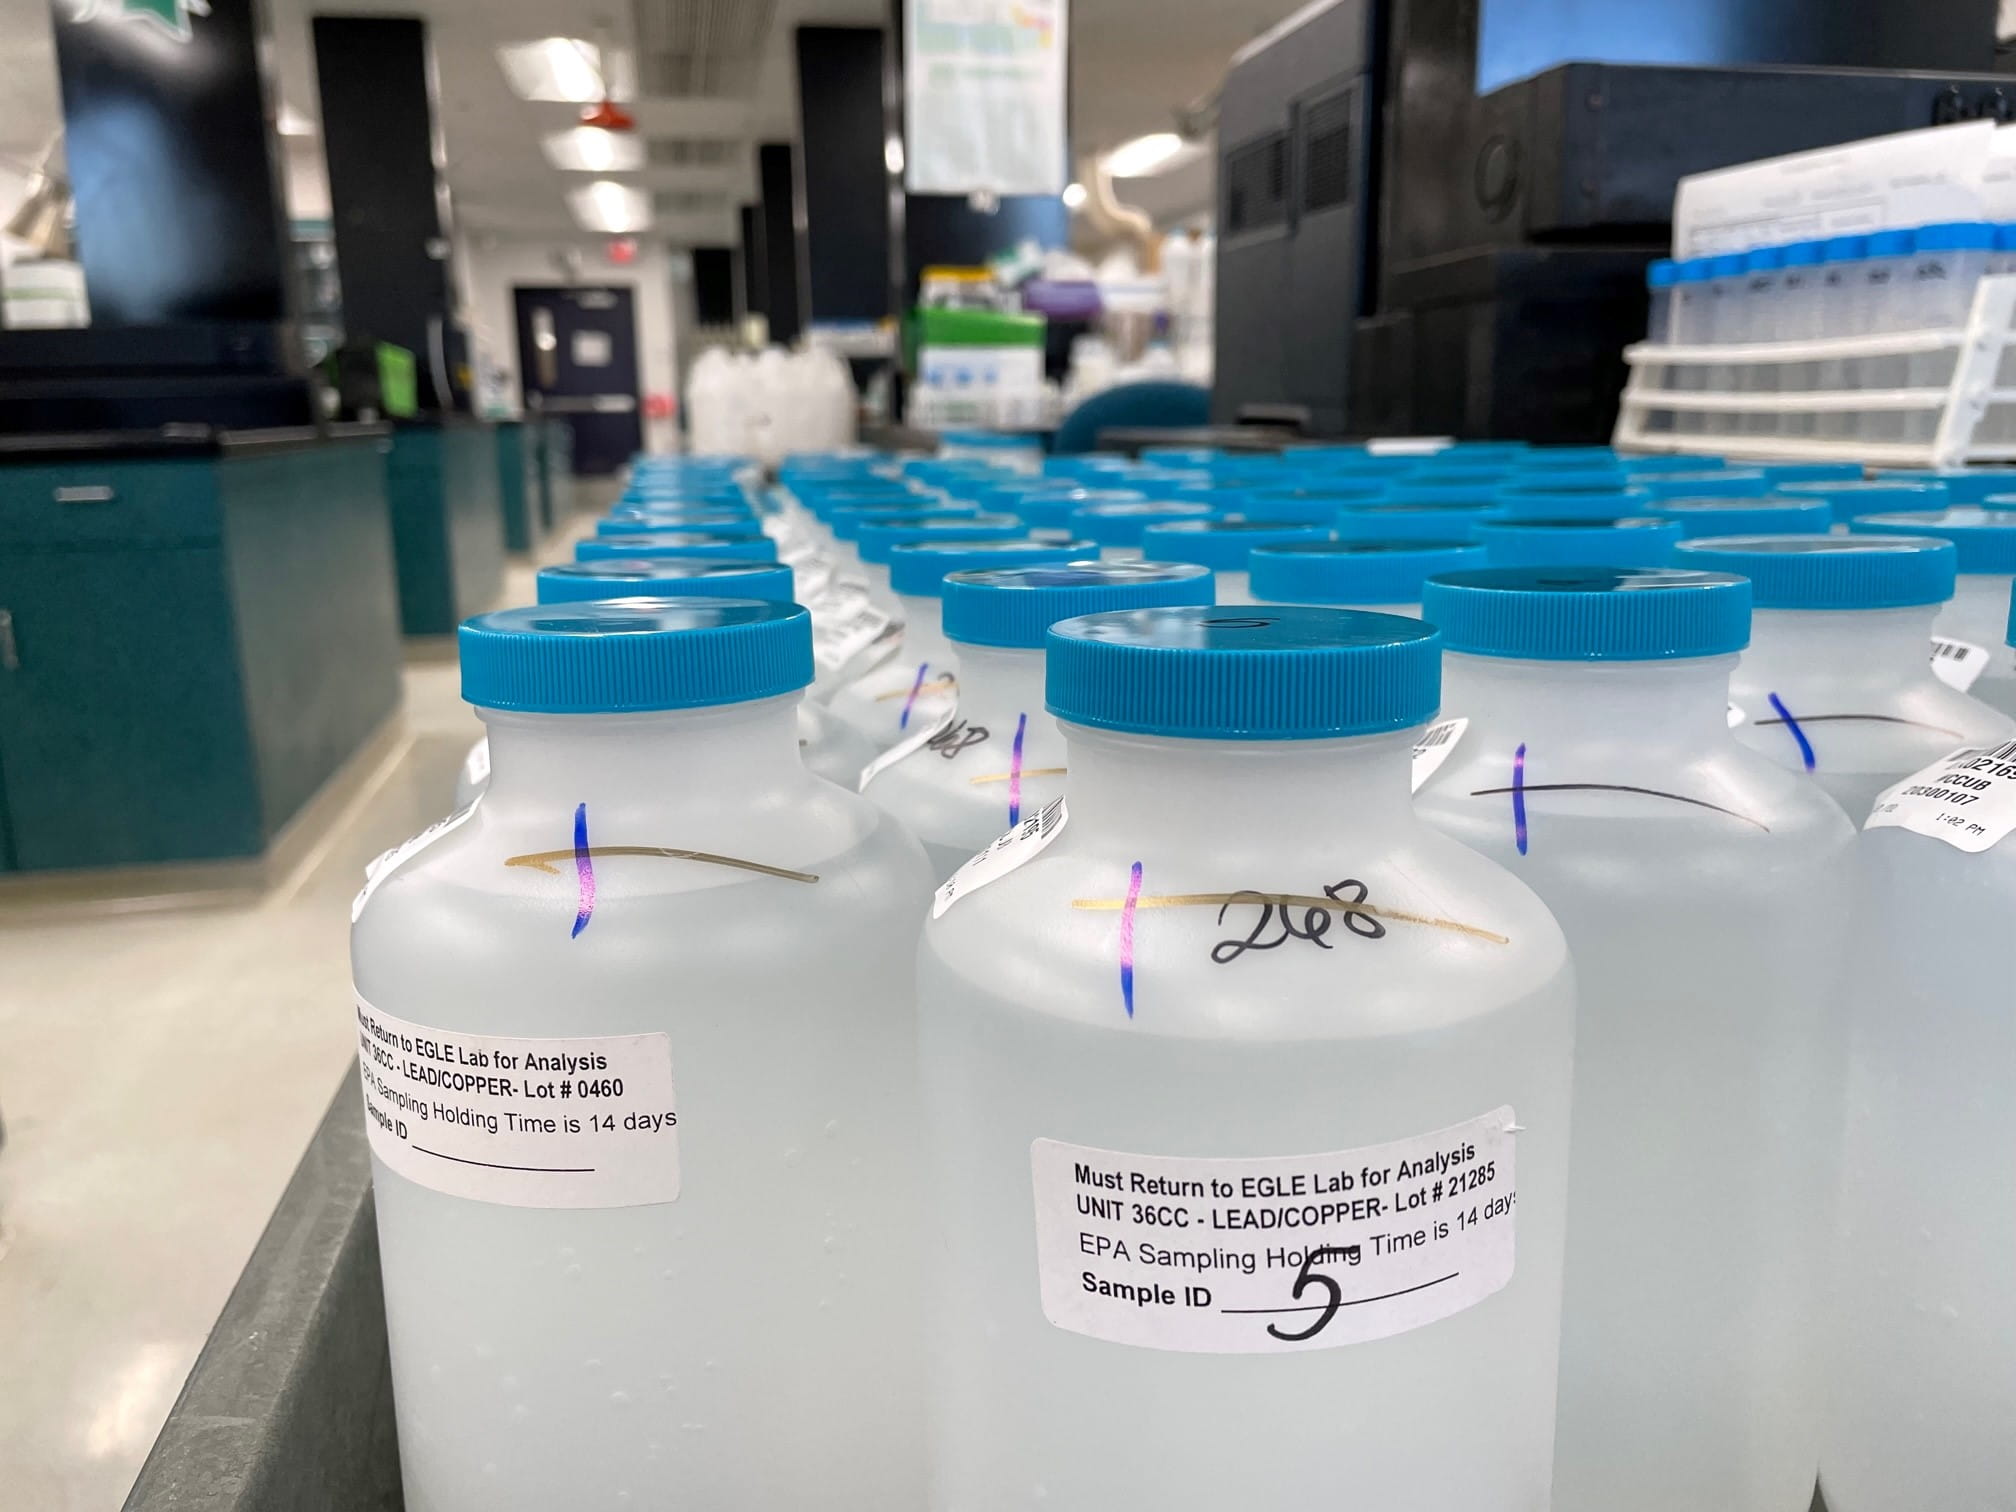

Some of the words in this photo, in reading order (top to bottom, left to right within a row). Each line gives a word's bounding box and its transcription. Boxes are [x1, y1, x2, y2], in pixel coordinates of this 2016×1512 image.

[1936, 812, 1965, 827] 1:02
[1965, 822, 1987, 836] PM
[1211, 878, 1386, 964] 268
[370, 1017, 398, 1048] Return
[401, 1034, 412, 1052] to
[415, 1038, 455, 1063] EGLE
[459, 1047, 488, 1068] Lab
[494, 1051, 518, 1069] for
[525, 1052, 607, 1075] Analysis
[372, 1043, 393, 1071] 36CC
[524, 1080, 555, 1098] Lot
[560, 1080, 572, 1099] #
[578, 1078, 623, 1098] 0460
[377, 1077, 428, 1120] Sampling
[433, 1101, 498, 1134] Holding
[503, 1113, 556, 1133] Time
[563, 1115, 581, 1133] is
[589, 1114, 616, 1132] 14
[623, 1111, 677, 1133] days
[395, 1119, 408, 1140] ID
[1074, 1162, 1124, 1192] Must
[1130, 1172, 1205, 1198] Return
[1211, 1178, 1233, 1198] to
[1241, 1174, 1306, 1198] EGLE
[1314, 1171, 1354, 1194] Lab
[1360, 1167, 1391, 1188] for
[1396, 1142, 1476, 1182] Analysis
[1076, 1193, 1124, 1221] UNIT
[1132, 1203, 1189, 1228] 36CC
[1395, 1188, 1427, 1213] Lot
[1431, 1180, 1443, 1203] #
[1448, 1160, 1495, 1198] 21285
[1079, 1231, 1131, 1262] EPA
[1139, 1243, 1256, 1275] Sampling
[1266, 1243, 1361, 1268] Holding
[1370, 1229, 1426, 1256] Time
[1433, 1220, 1449, 1241] is
[1457, 1206, 1479, 1232] 14
[1082, 1271, 1175, 1307] Sample
[1185, 1286, 1212, 1308] ID
[1267, 1245, 1361, 1342] 5
